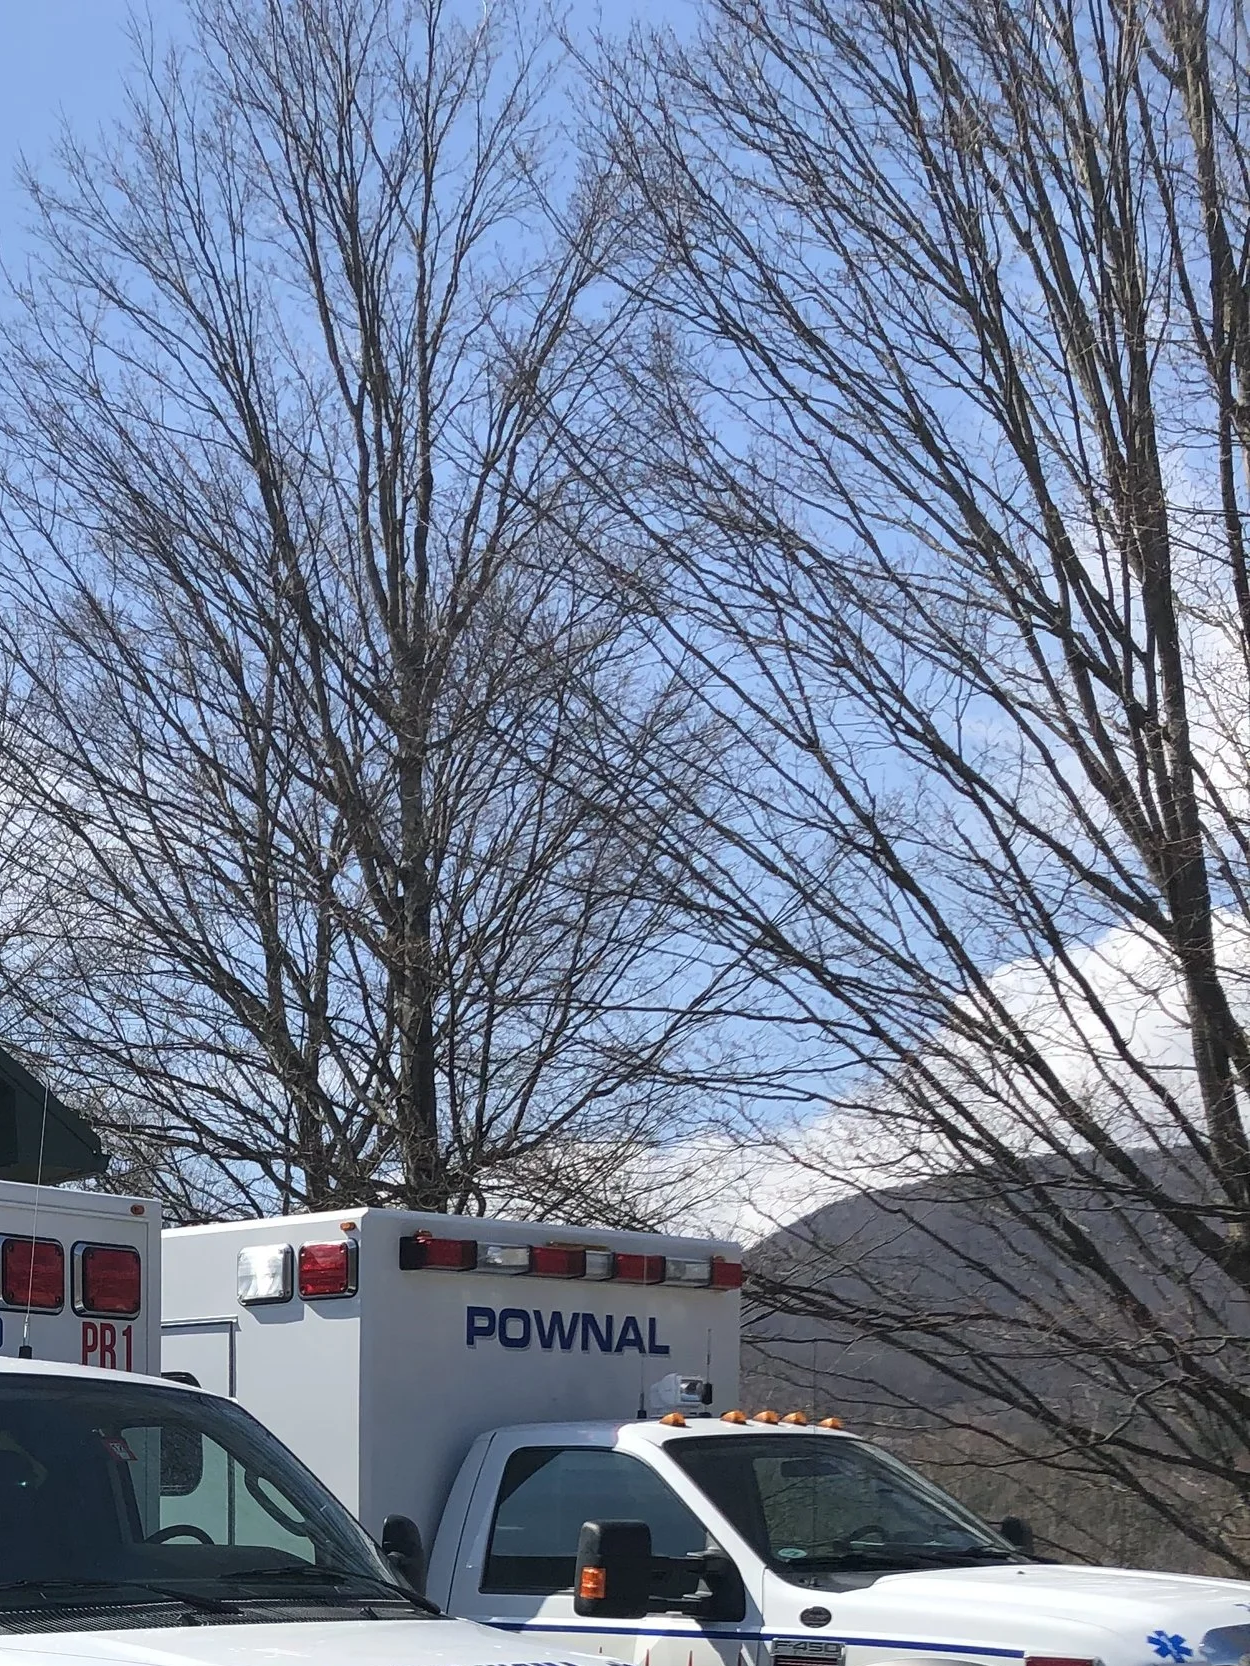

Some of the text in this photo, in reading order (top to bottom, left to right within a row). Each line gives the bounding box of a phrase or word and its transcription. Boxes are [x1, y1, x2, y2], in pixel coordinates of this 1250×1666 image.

[81, 1321, 132, 1372] PR1
[466, 1305, 671, 1356] POWNAL
[774, 1640, 841, 1653] F-450
